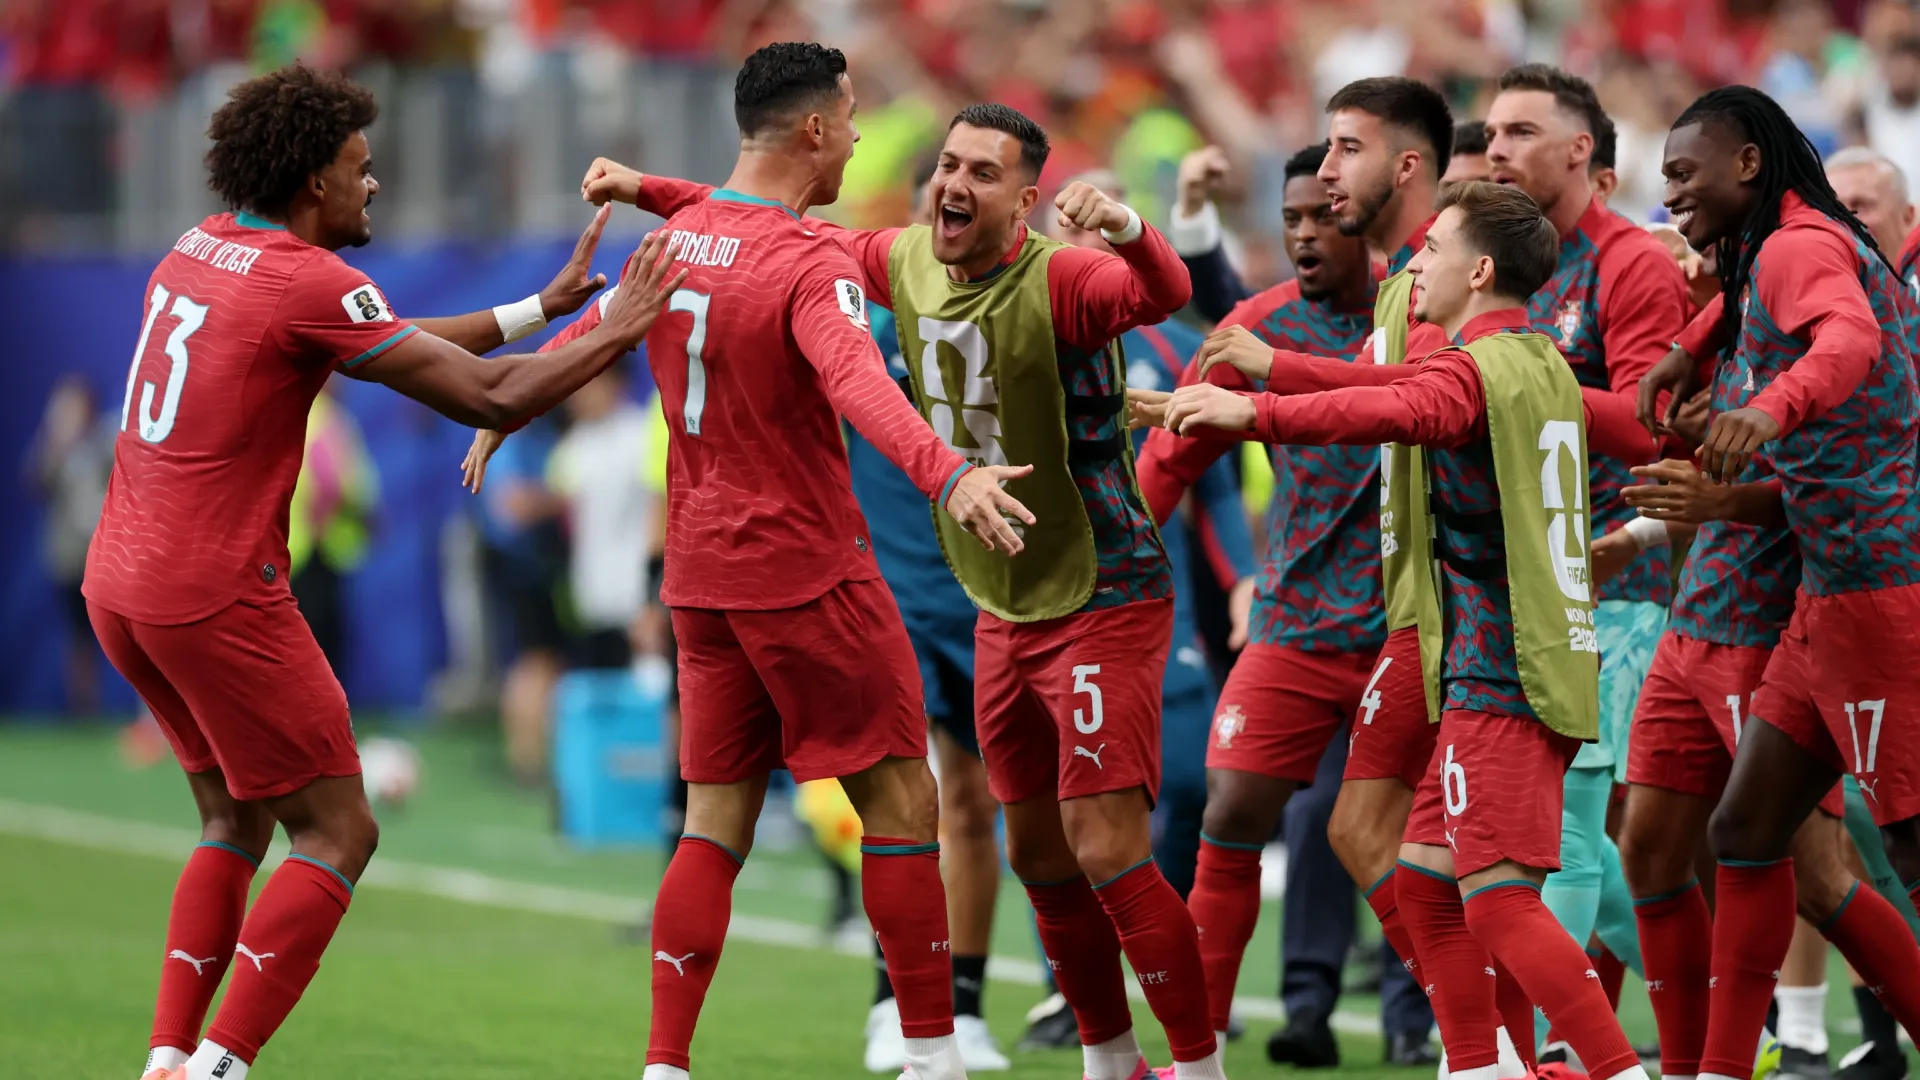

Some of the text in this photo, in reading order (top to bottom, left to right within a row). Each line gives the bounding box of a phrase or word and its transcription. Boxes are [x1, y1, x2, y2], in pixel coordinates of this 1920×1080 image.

[173, 226, 263, 276] ENATO VEIGA
[664, 229, 742, 268] RONALDO
[120, 282, 211, 445] 13
[668, 287, 712, 436] 7
[1566, 566, 1587, 585] FIFA
[1071, 663, 1104, 735] 5
[1843, 698, 1887, 774] 17
[1440, 743, 1468, 817] 6
